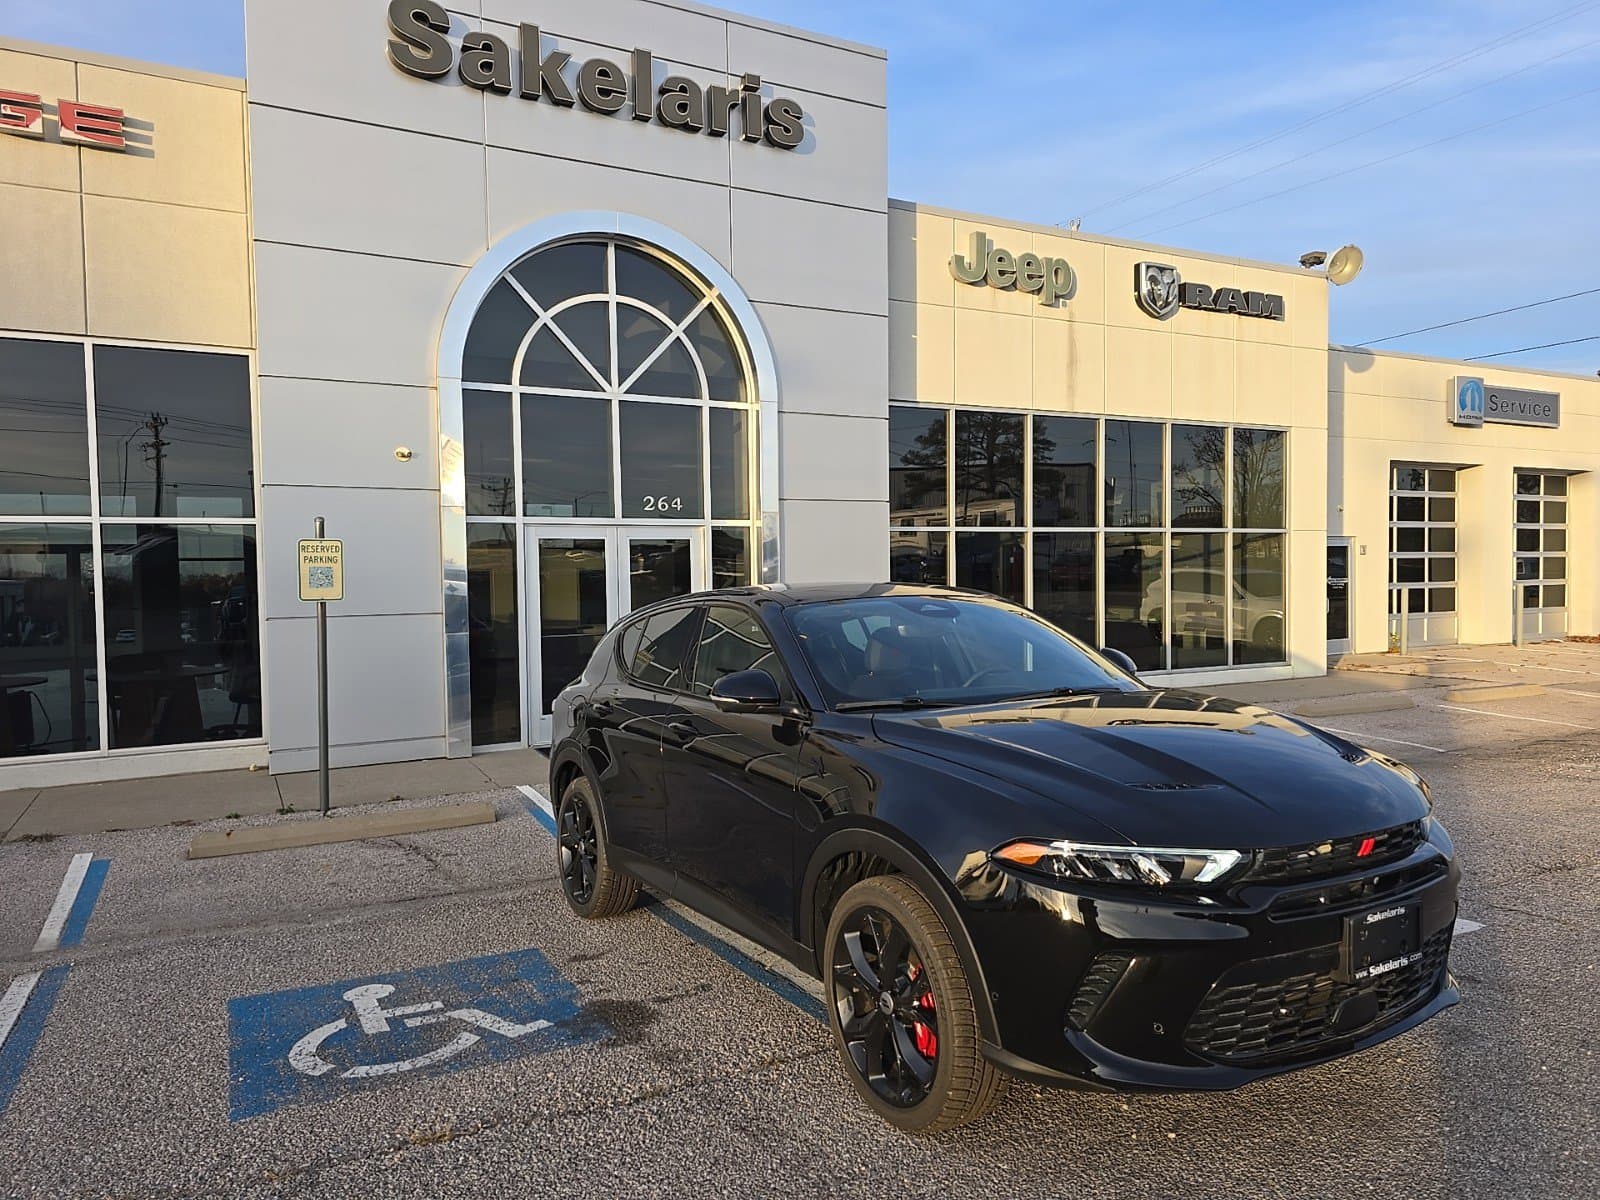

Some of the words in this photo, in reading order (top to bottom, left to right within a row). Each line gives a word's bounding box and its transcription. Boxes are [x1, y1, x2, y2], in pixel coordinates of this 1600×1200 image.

[388, 0, 805, 149] Sakelaris
[951, 231, 1074, 305] Jeep
[1180, 282, 1284, 320] RAM
[1488, 394, 1552, 417] Service
[643, 495, 683, 512] 264
[300, 544, 340, 554] RESERVED
[303, 555, 338, 564] PARKING
[1364, 906, 1406, 924] Sakelaris
